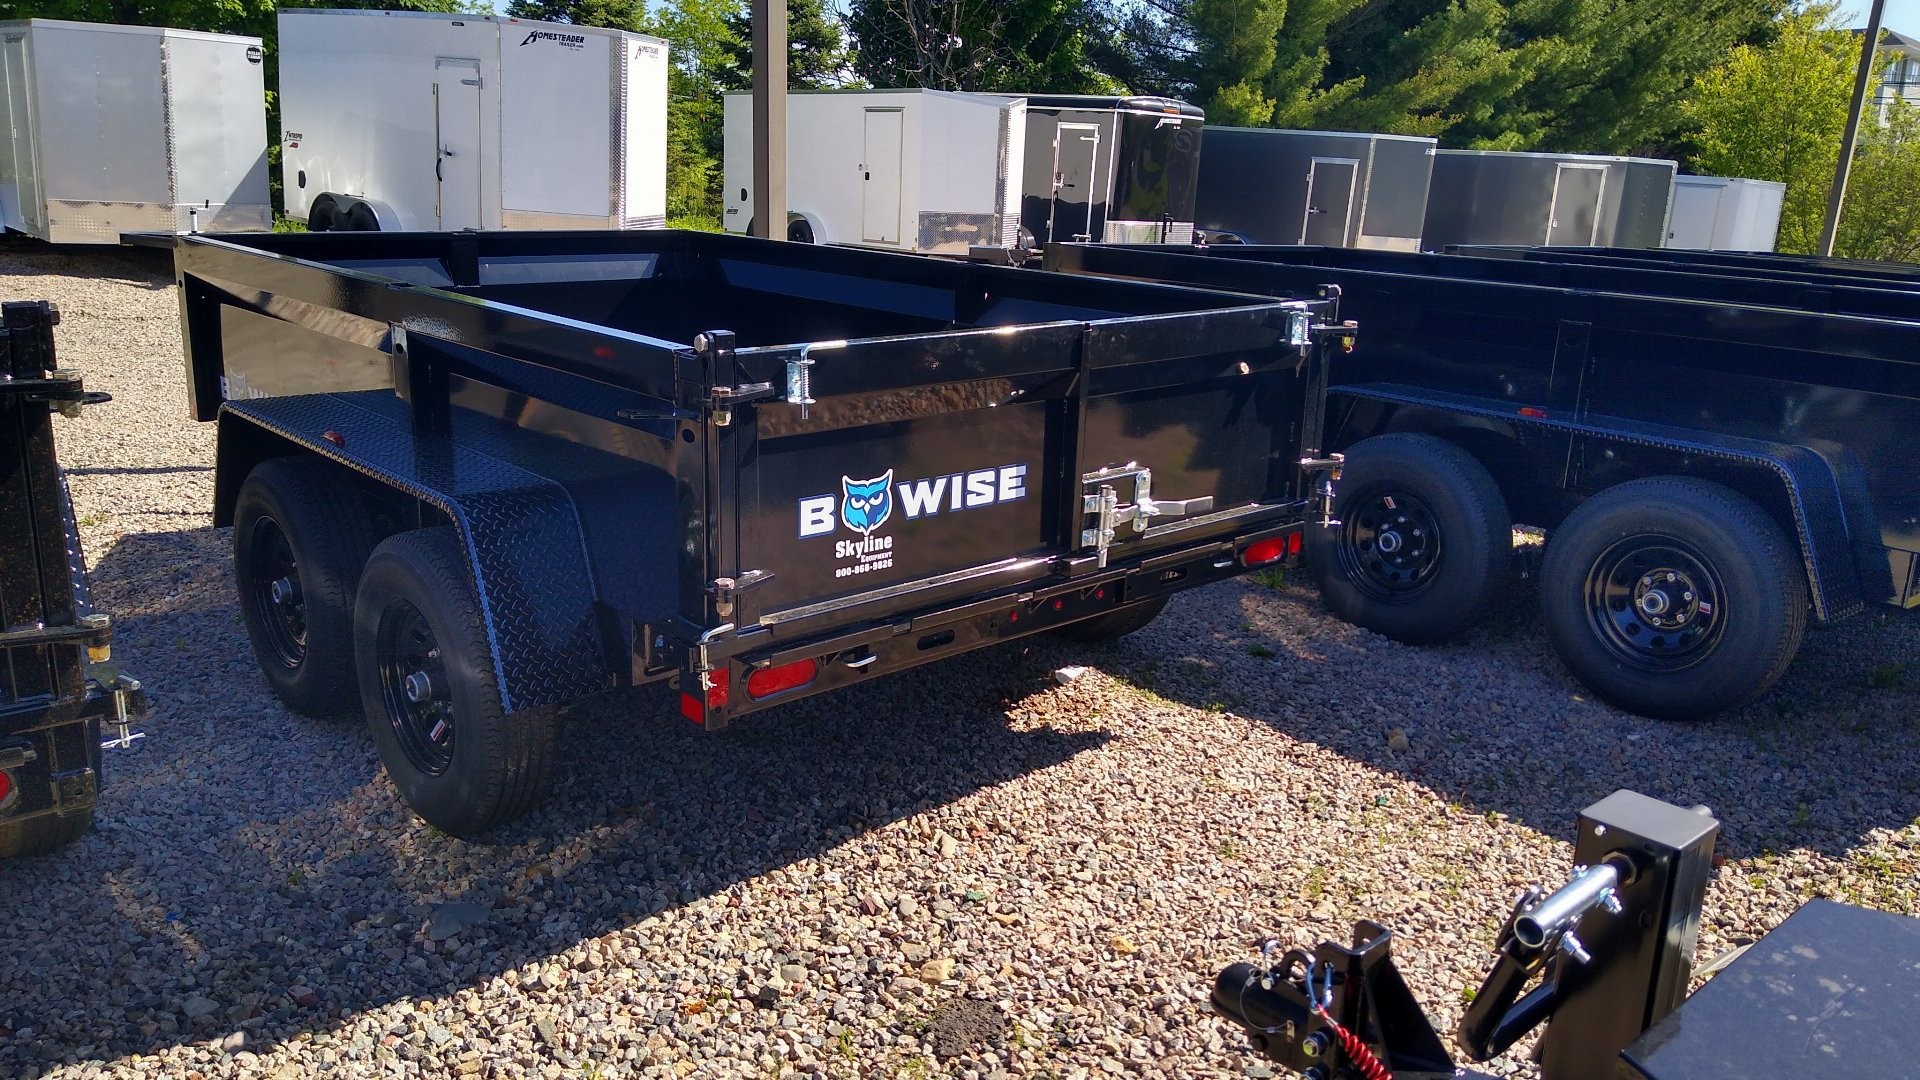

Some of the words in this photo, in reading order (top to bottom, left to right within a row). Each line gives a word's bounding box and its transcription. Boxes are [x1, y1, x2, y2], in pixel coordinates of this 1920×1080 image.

[520, 30, 585, 47] HOMESTEADER
[896, 464, 1027, 520] WISE
[835, 535, 893, 559] Skyline
